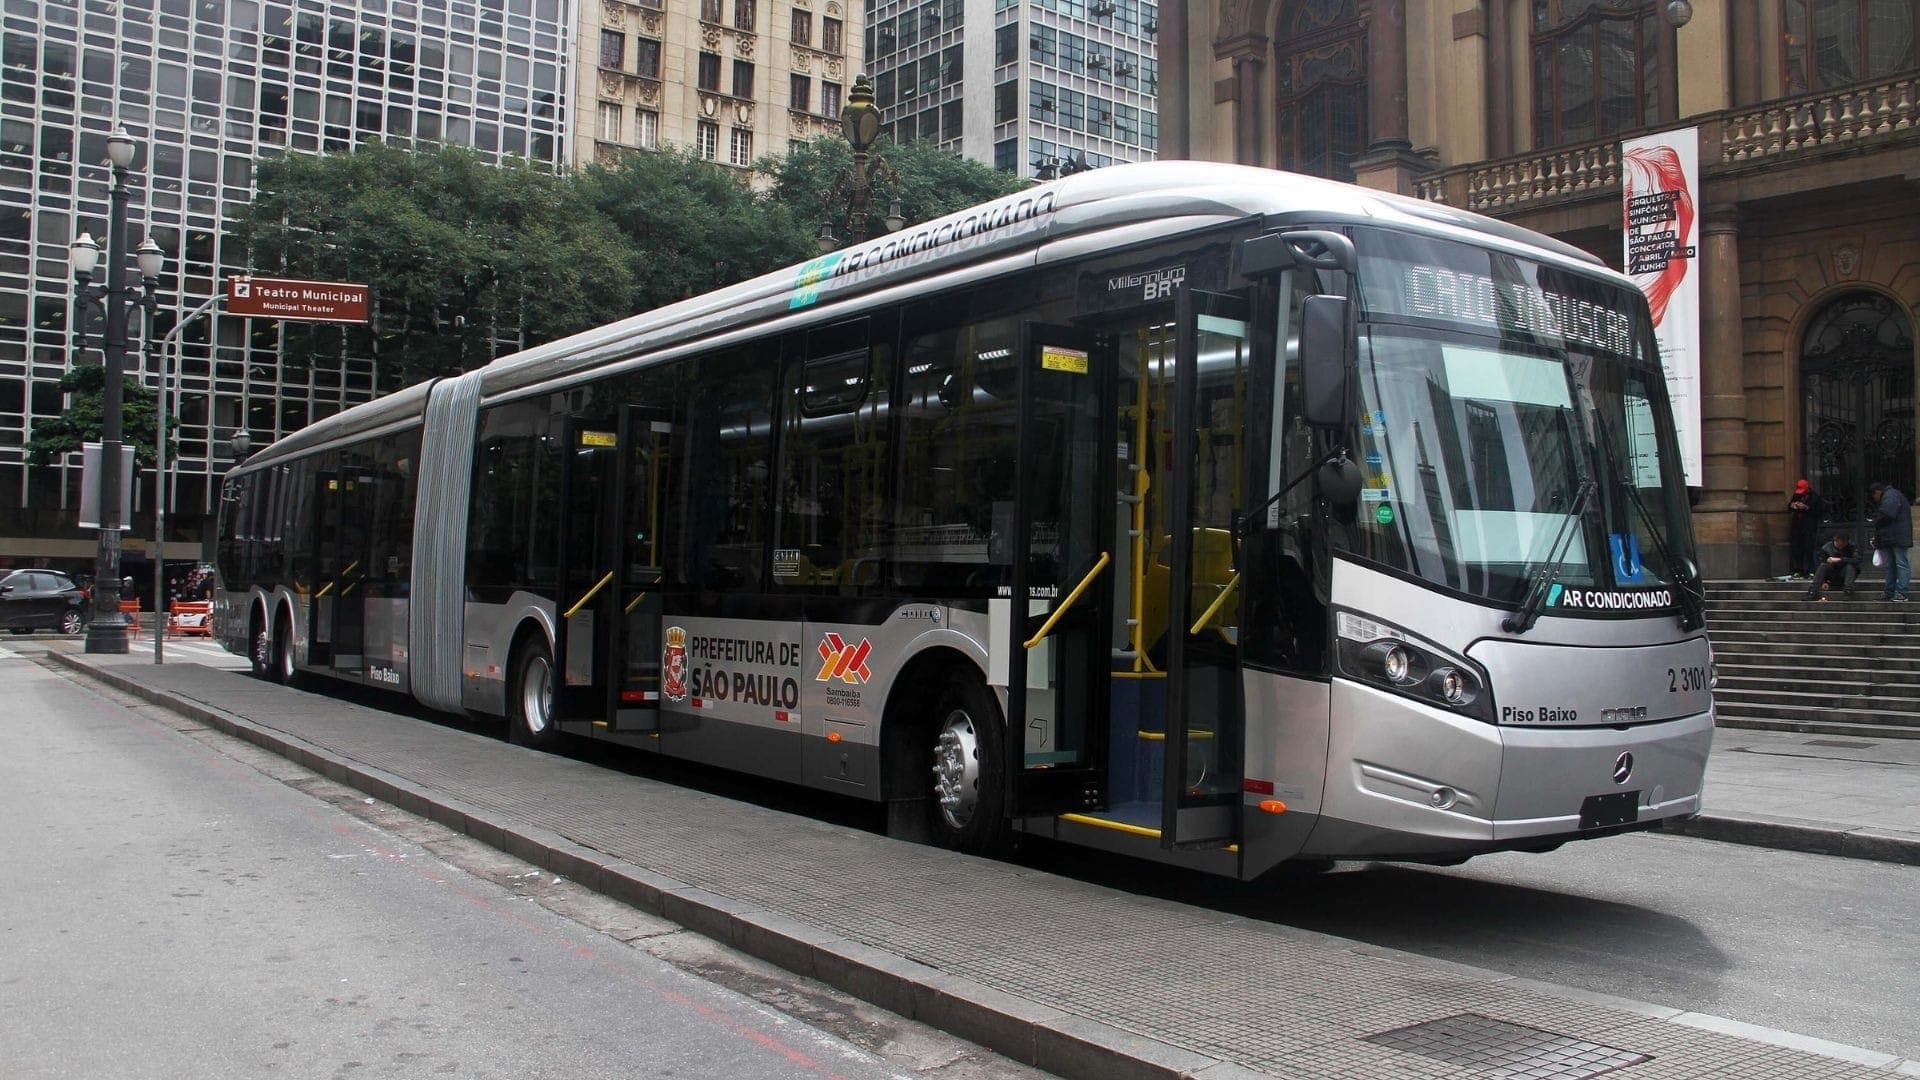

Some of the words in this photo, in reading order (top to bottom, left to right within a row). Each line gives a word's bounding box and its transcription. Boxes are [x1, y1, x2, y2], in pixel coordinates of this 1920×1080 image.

[1629, 203, 1669, 216] SINFÔNCA
[1629, 213, 1672, 225] MUNICIPA
[1630, 235, 1645, 245] SÃO
[1647, 232, 1672, 242] PAULO
[1630, 241, 1675, 254] CONCERTOS
[1638, 253, 1662, 262] ABRIL
[1638, 262, 1667, 272] JUNHO
[1108, 267, 1186, 291] Millennium
[255, 286, 299, 298] Teatro
[302, 289, 362, 303] Municipal
[1143, 277, 1185, 300] BRT
[262, 302, 300, 311] Municipal
[301, 304, 335, 313] Theater
[1412, 266, 1496, 322] CAIO
[1512, 284, 1631, 356] INDUSCAR
[1563, 590, 1583, 607] AR
[1585, 590, 1671, 609] CONDICIONADO
[692, 636, 774, 664] PREFEITURA
[779, 642, 799, 667] DE
[692, 662, 729, 700] SÃO
[733, 672, 799, 710] PAULO
[1668, 668, 1676, 692] 2
[1681, 667, 1707, 691] 3101
[1502, 706, 1534, 722] Piso
[1539, 706, 1577, 722] Baixo
